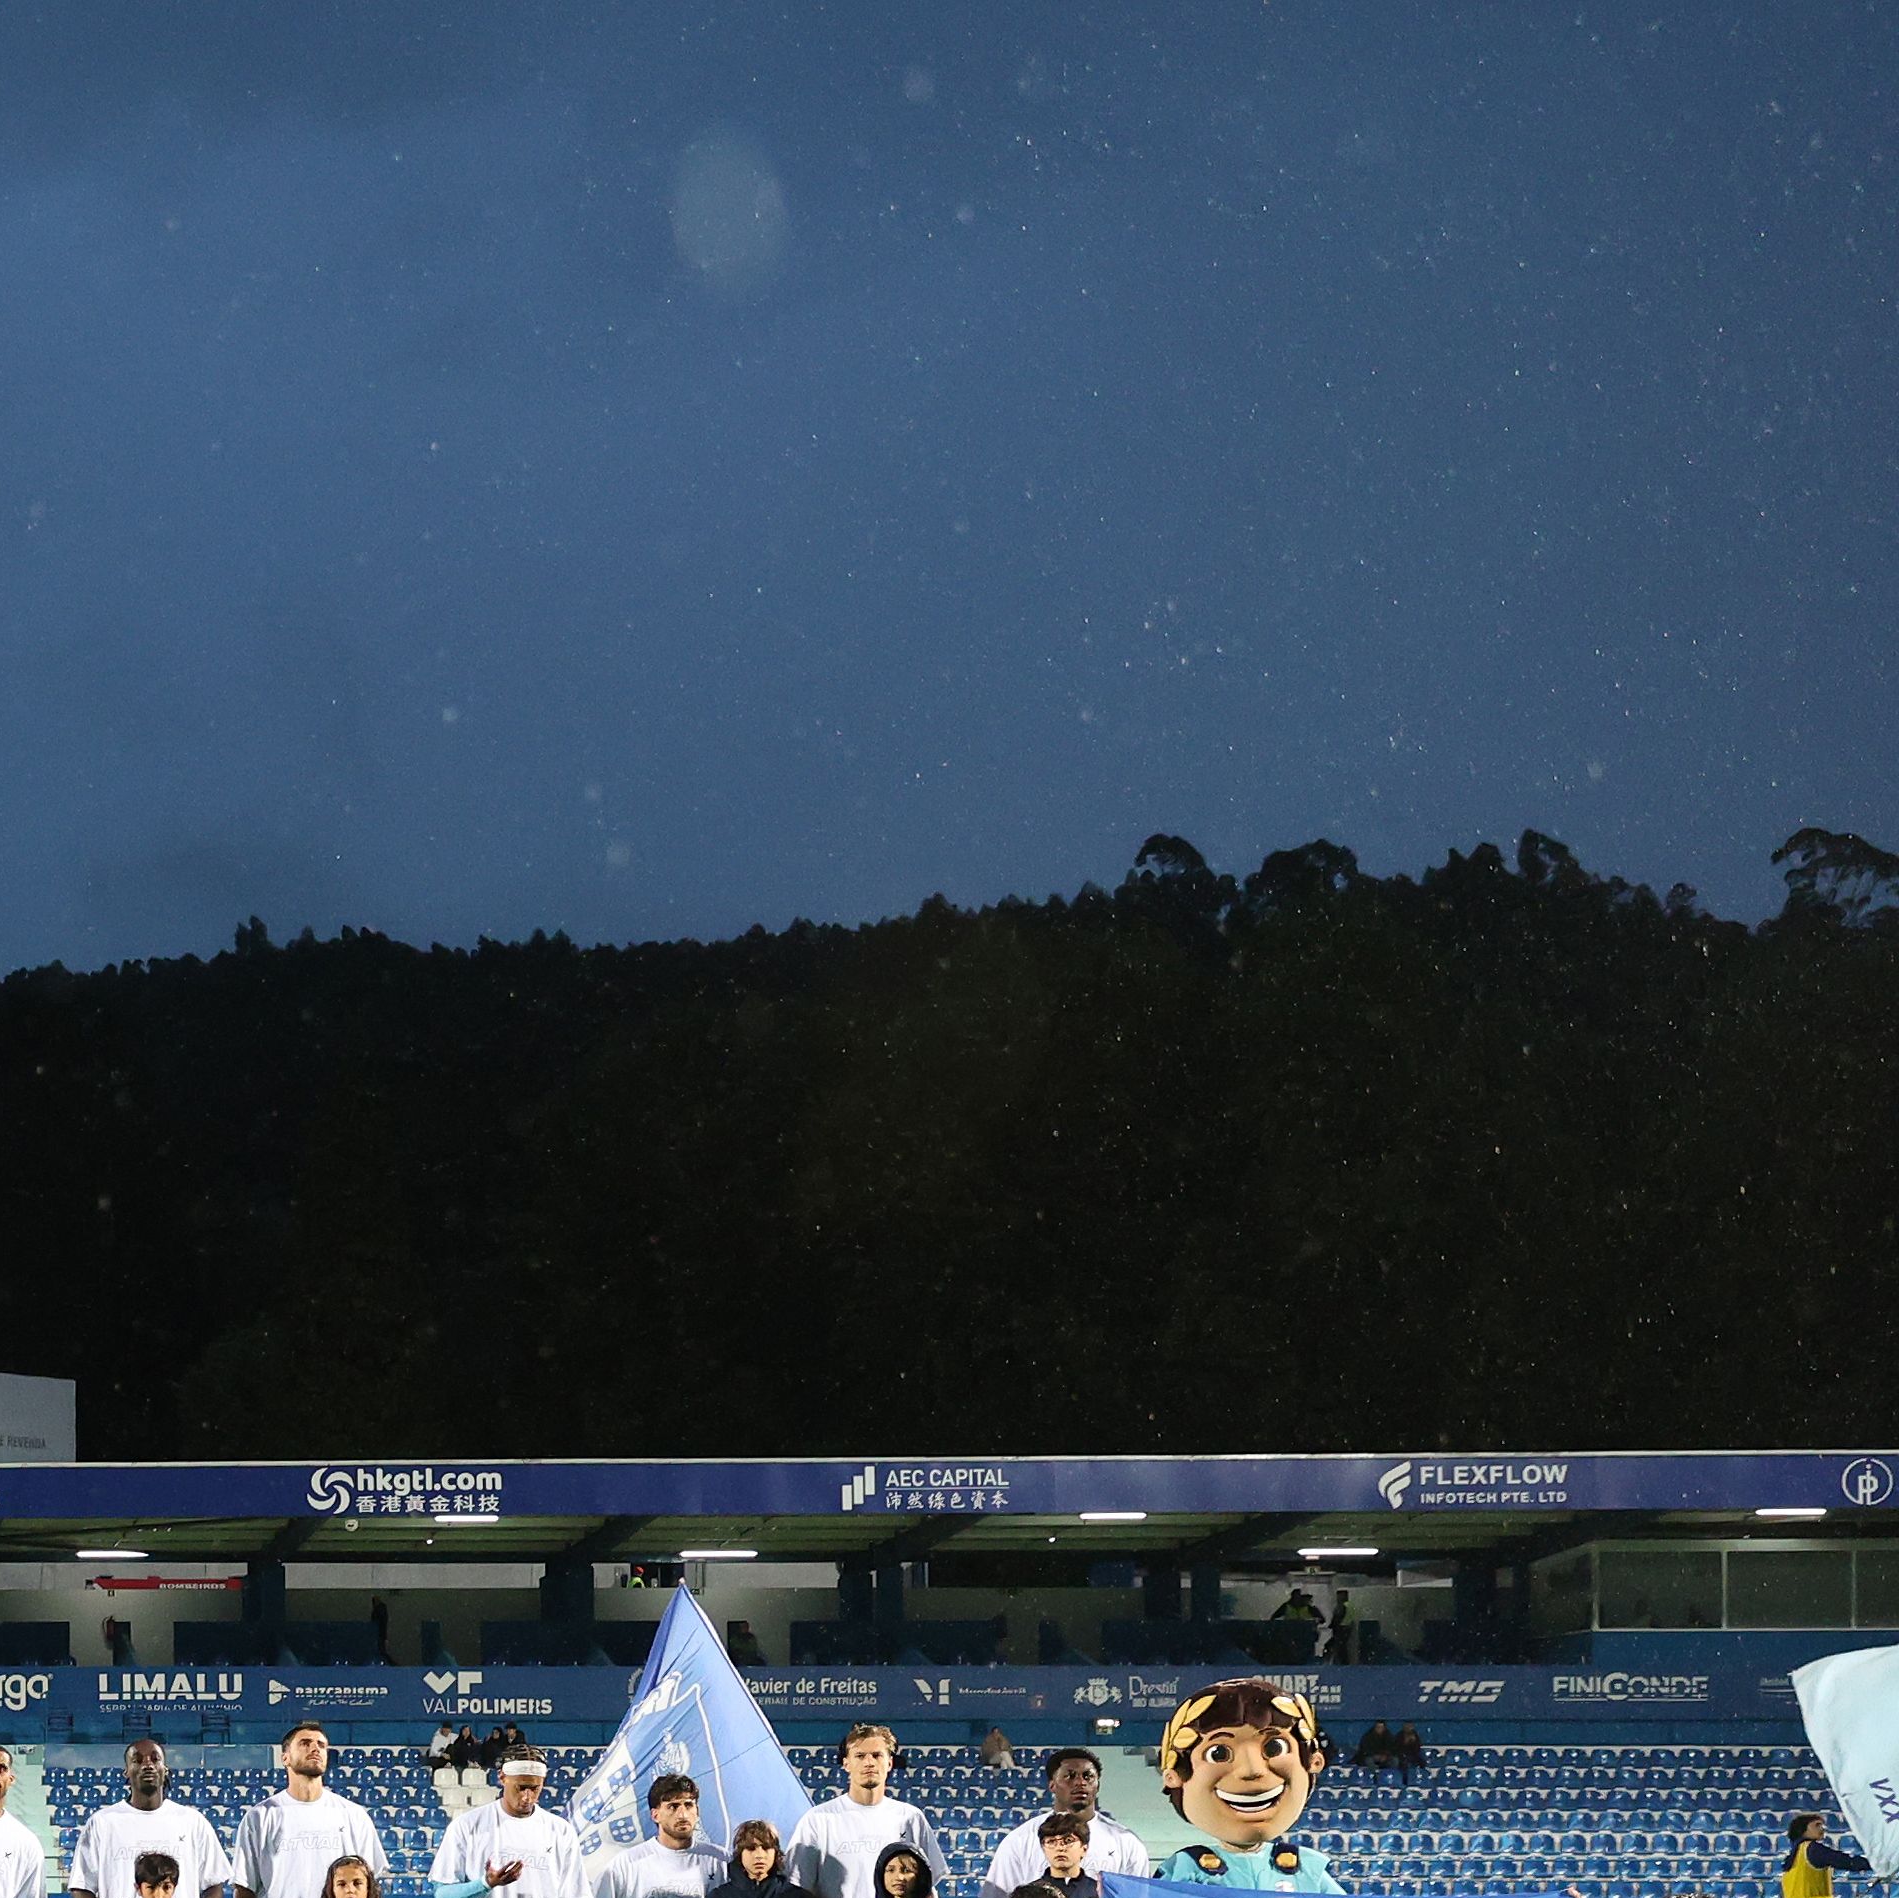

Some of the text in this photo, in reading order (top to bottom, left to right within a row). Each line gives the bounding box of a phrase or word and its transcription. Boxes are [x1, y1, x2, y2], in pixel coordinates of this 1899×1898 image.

[357, 1468, 503, 1496] hkgtl.com
[885, 1468, 1010, 1487] AEC CAPITAL
[1420, 1464, 1569, 1486] FLEXFLOW
[1420, 1491, 1568, 1505] INFOTECH PTE. LTD
[99, 1673, 243, 1701] LIMALU
[795, 1678, 814, 1694] de
[820, 1677, 877, 1694] Freitas
[422, 1698, 553, 1715] VALPOLIMERS
[277, 1837, 342, 1852] ATUAL
